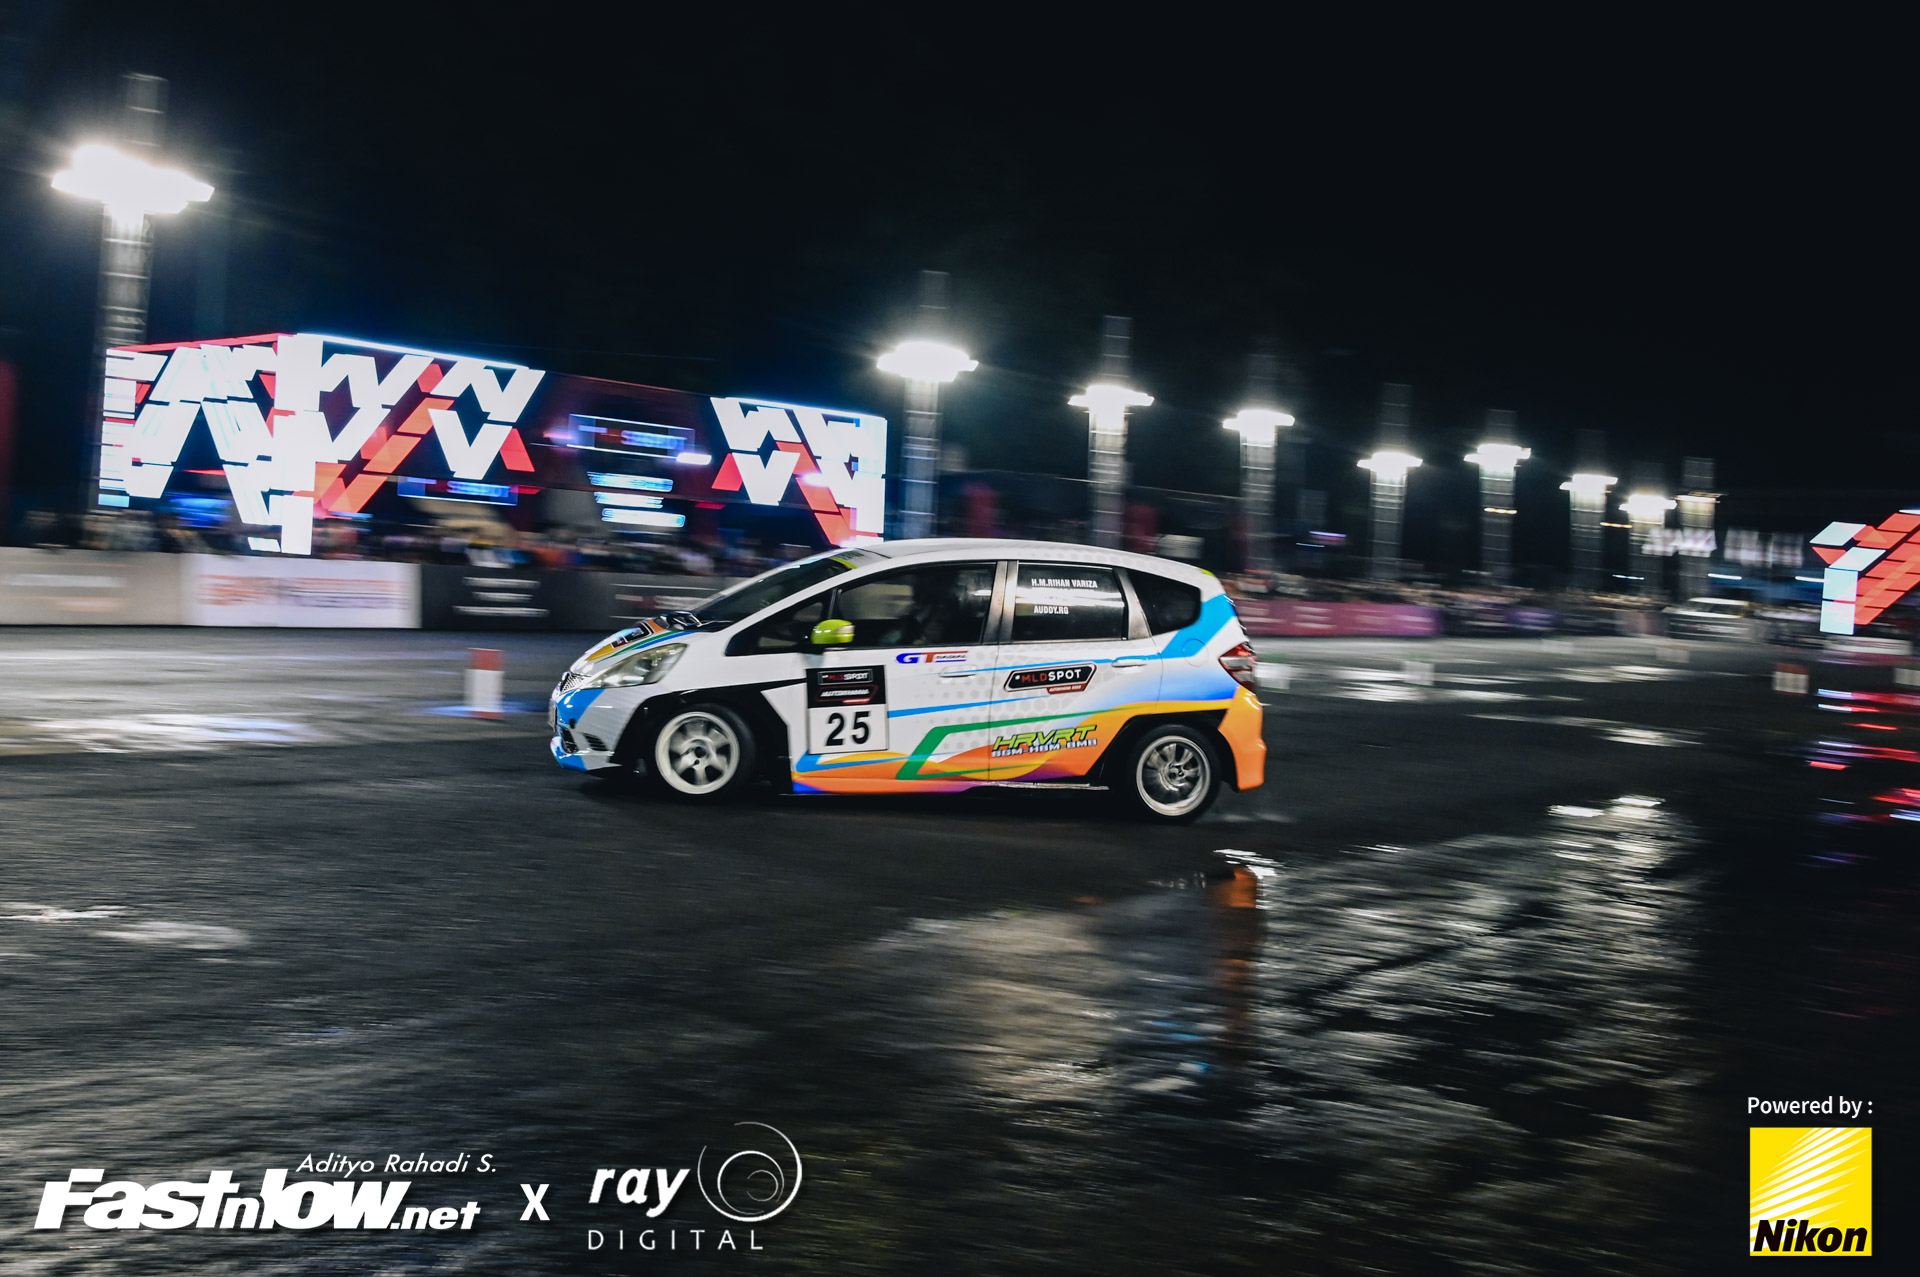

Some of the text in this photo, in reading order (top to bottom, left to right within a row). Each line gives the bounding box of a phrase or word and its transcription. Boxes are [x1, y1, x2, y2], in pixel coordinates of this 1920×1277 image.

[1031, 578, 1098, 589] H.M.RIHAN VARIZA
[1033, 605, 1069, 615] AUDDY.RG
[1021, 669, 1082, 684] MLDSPOT
[825, 711, 870, 746] 25
[992, 725, 1098, 751] HRVRT
